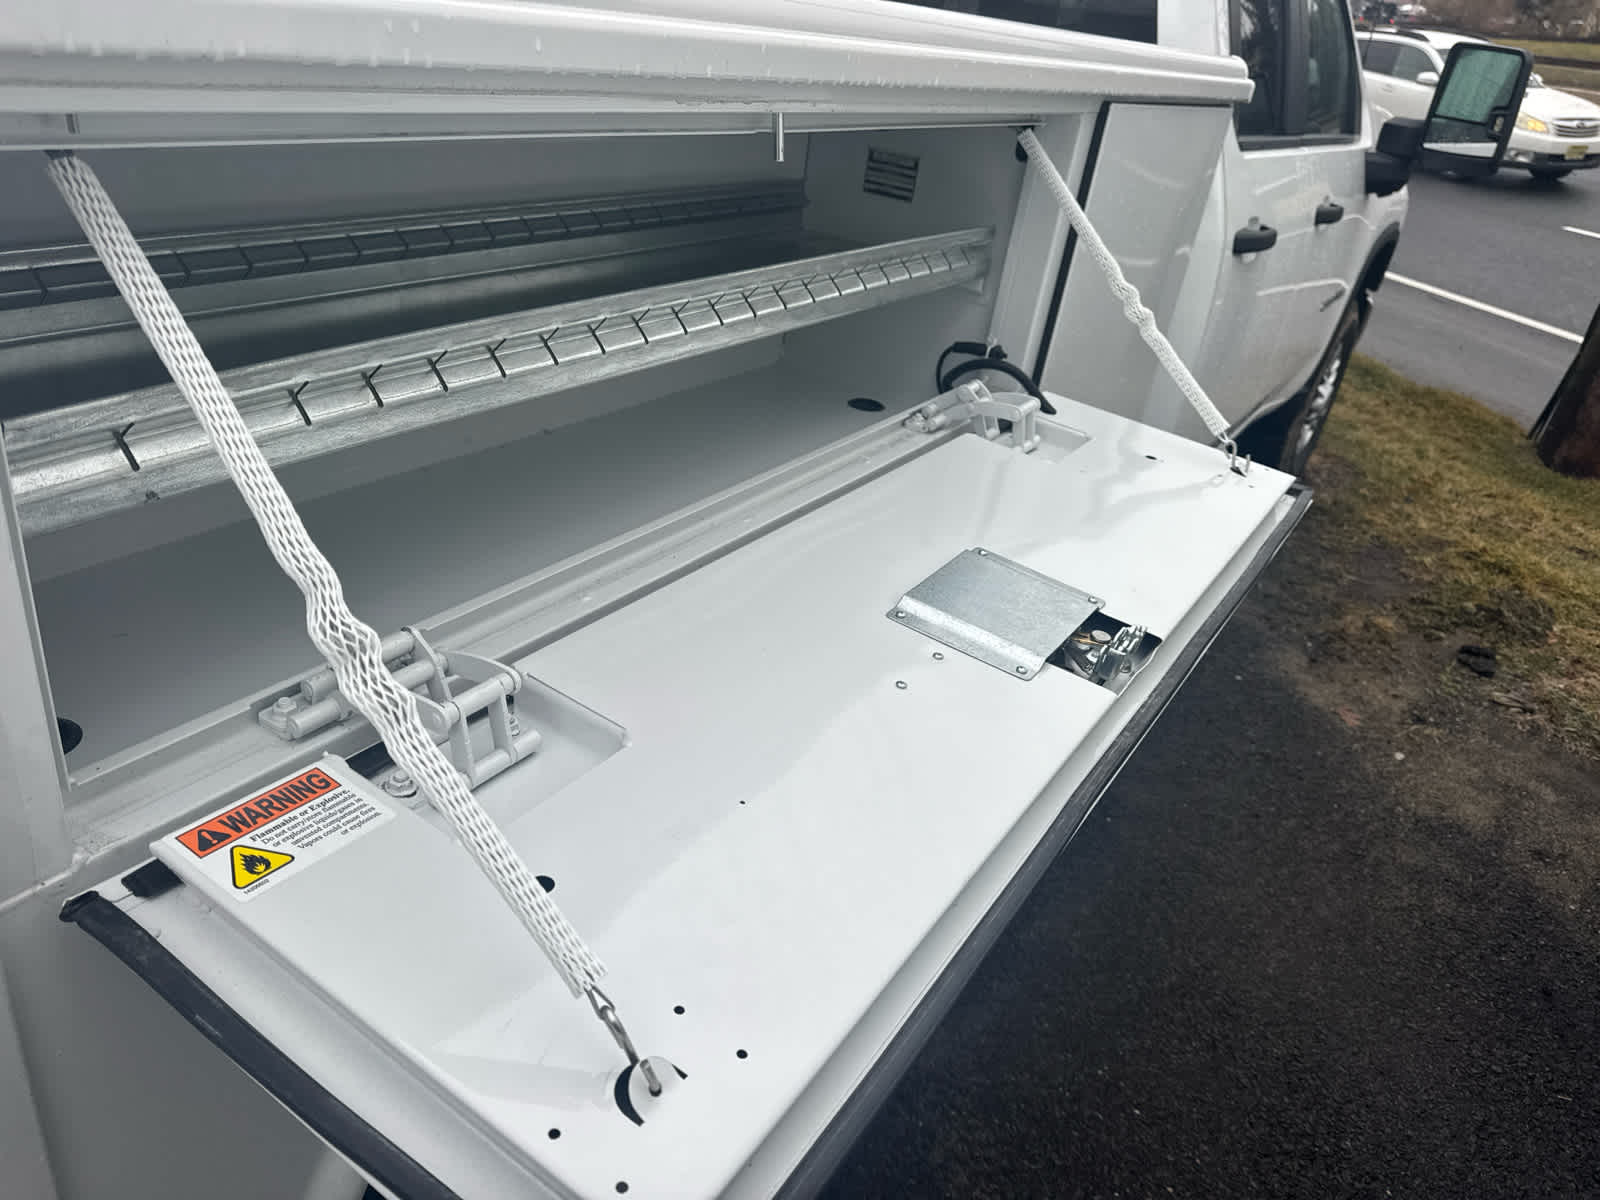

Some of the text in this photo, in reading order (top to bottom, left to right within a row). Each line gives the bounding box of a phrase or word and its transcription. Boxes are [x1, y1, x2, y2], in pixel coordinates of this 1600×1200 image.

[218, 773, 331, 834] WARNING
[248, 787, 351, 842] Flammable or Explosive.
[260, 834, 275, 844] Do
[273, 829, 287, 838] not
[279, 822, 315, 843] explosive
[296, 833, 325, 851] Vapors
[320, 823, 342, 837] could
[340, 814, 361, 826] cause
